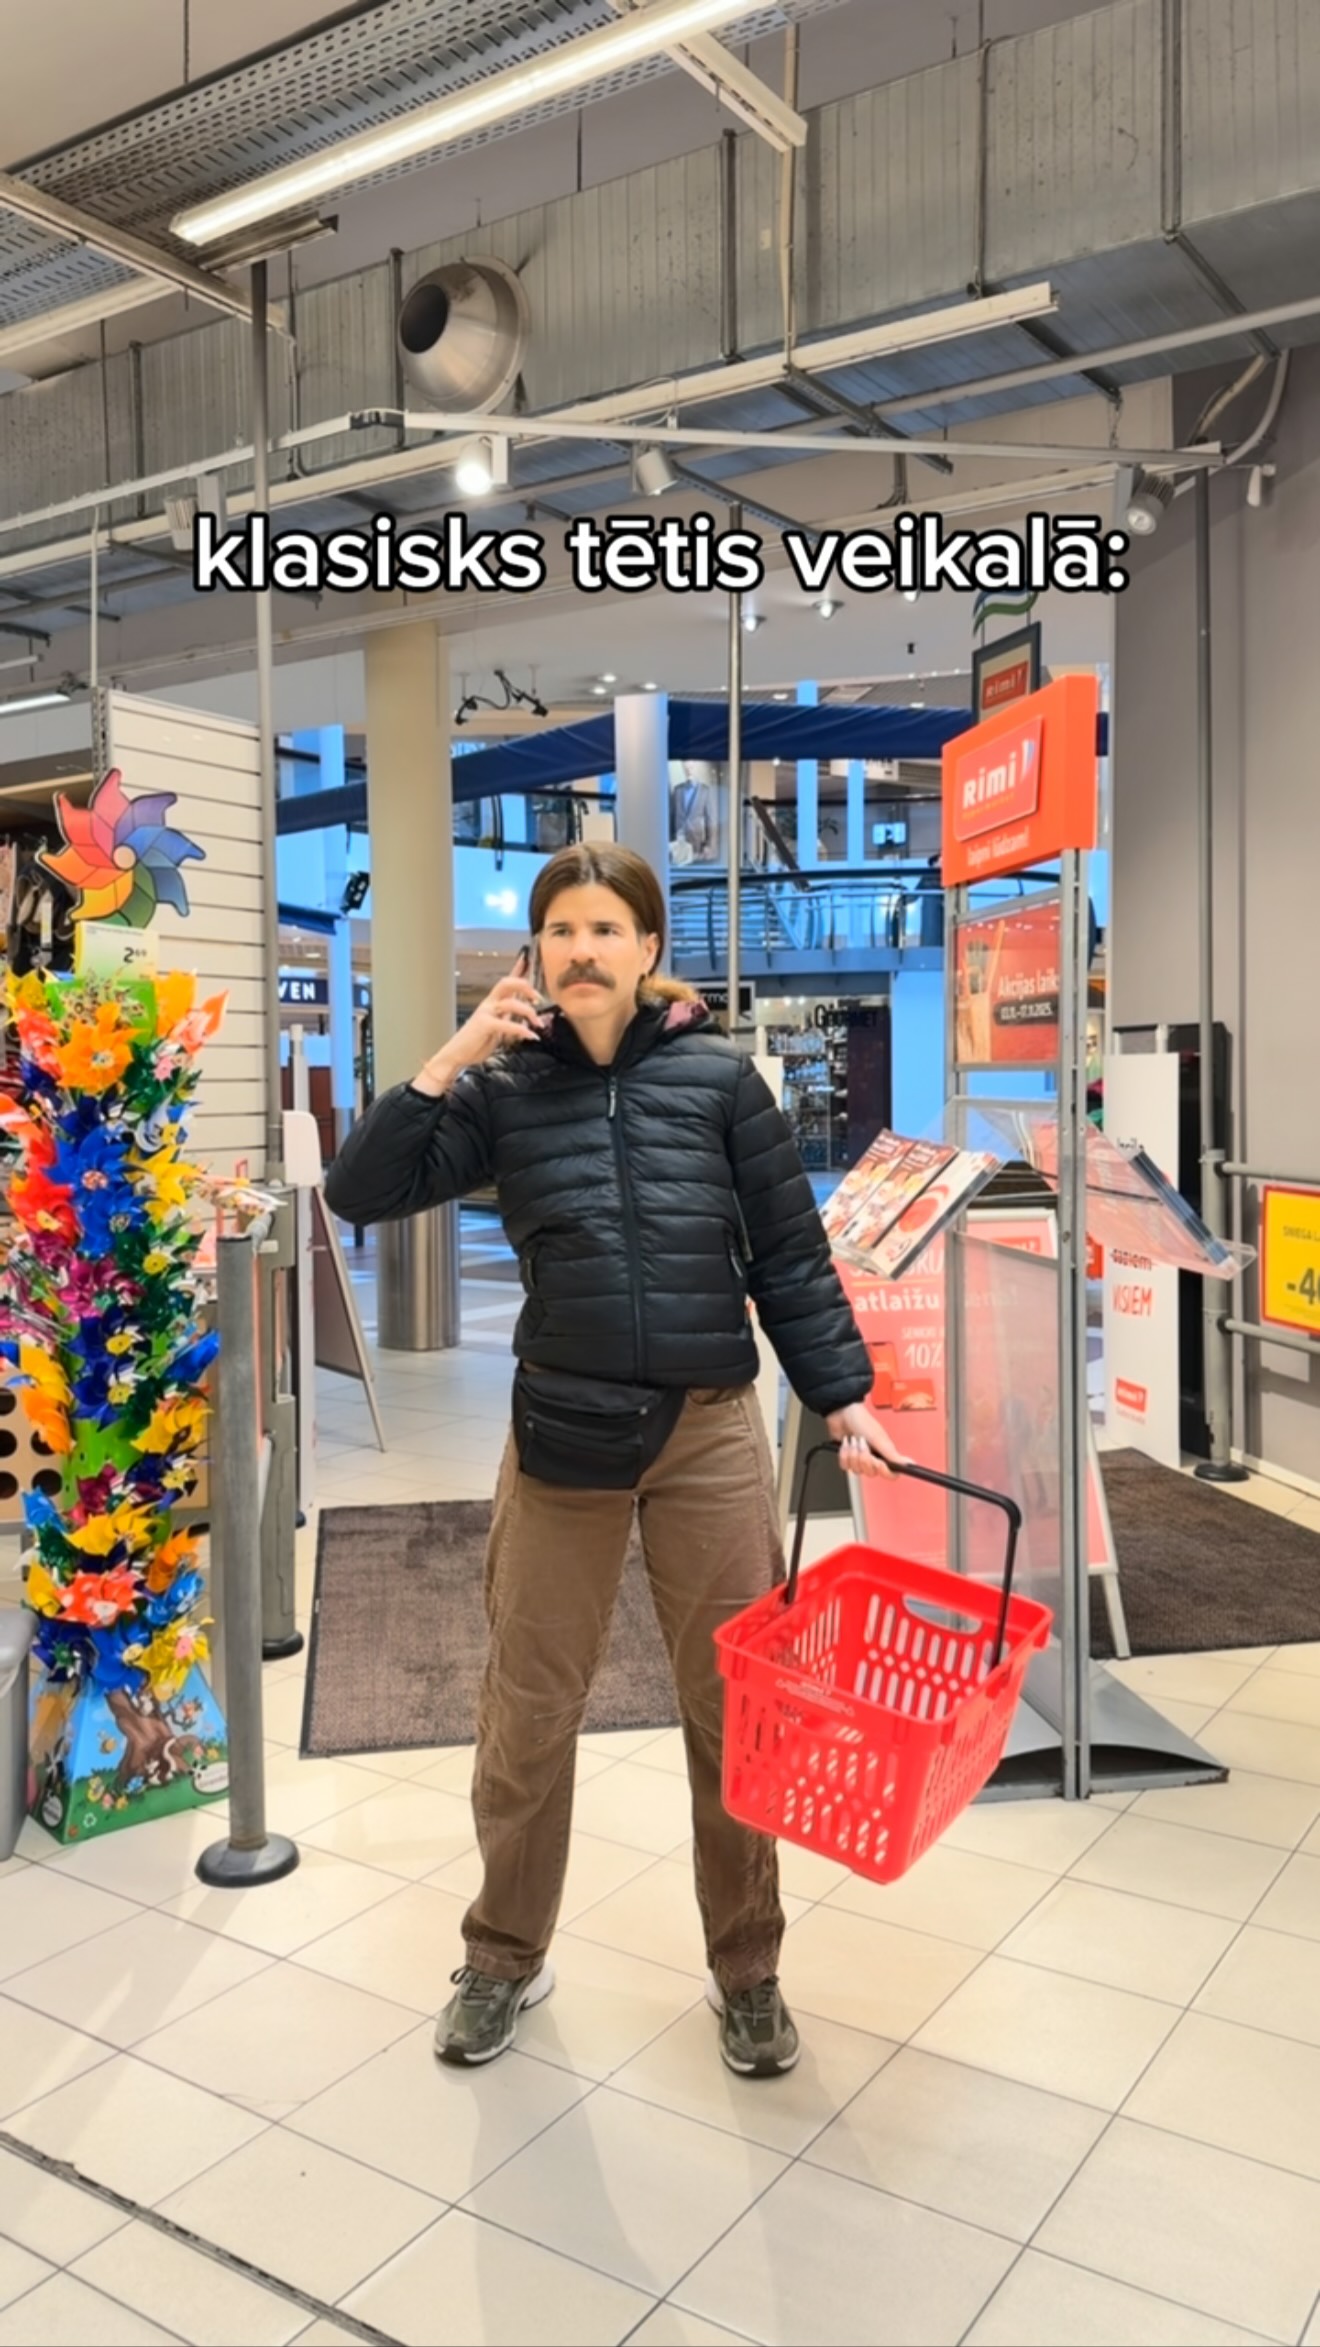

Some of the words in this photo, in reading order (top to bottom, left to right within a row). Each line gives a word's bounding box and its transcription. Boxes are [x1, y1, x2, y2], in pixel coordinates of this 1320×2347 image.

[962, 750, 1017, 810] Rimi
[854, 1287, 940, 1313] atlaižu
[1112, 1284, 1152, 1317] VISIEM
